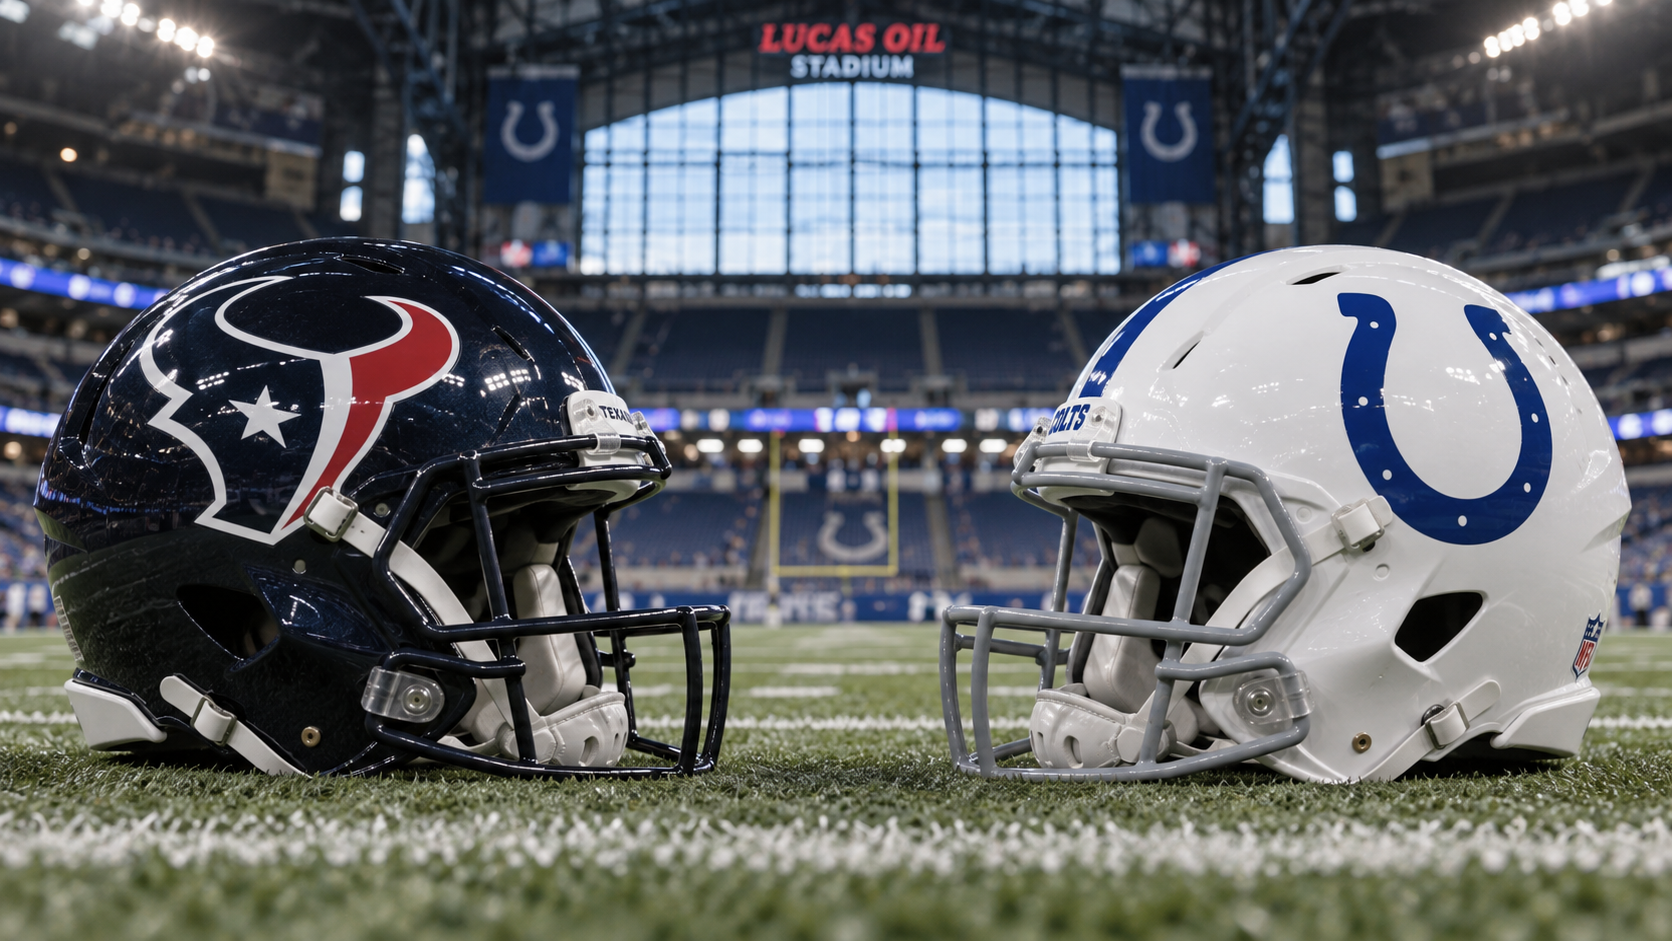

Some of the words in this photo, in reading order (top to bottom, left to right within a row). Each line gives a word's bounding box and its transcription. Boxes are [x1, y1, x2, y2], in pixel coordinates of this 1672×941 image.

[758, 22, 877, 54] LUCAS
[882, 22, 946, 54] OIL
[790, 54, 914, 79] STADIUM
